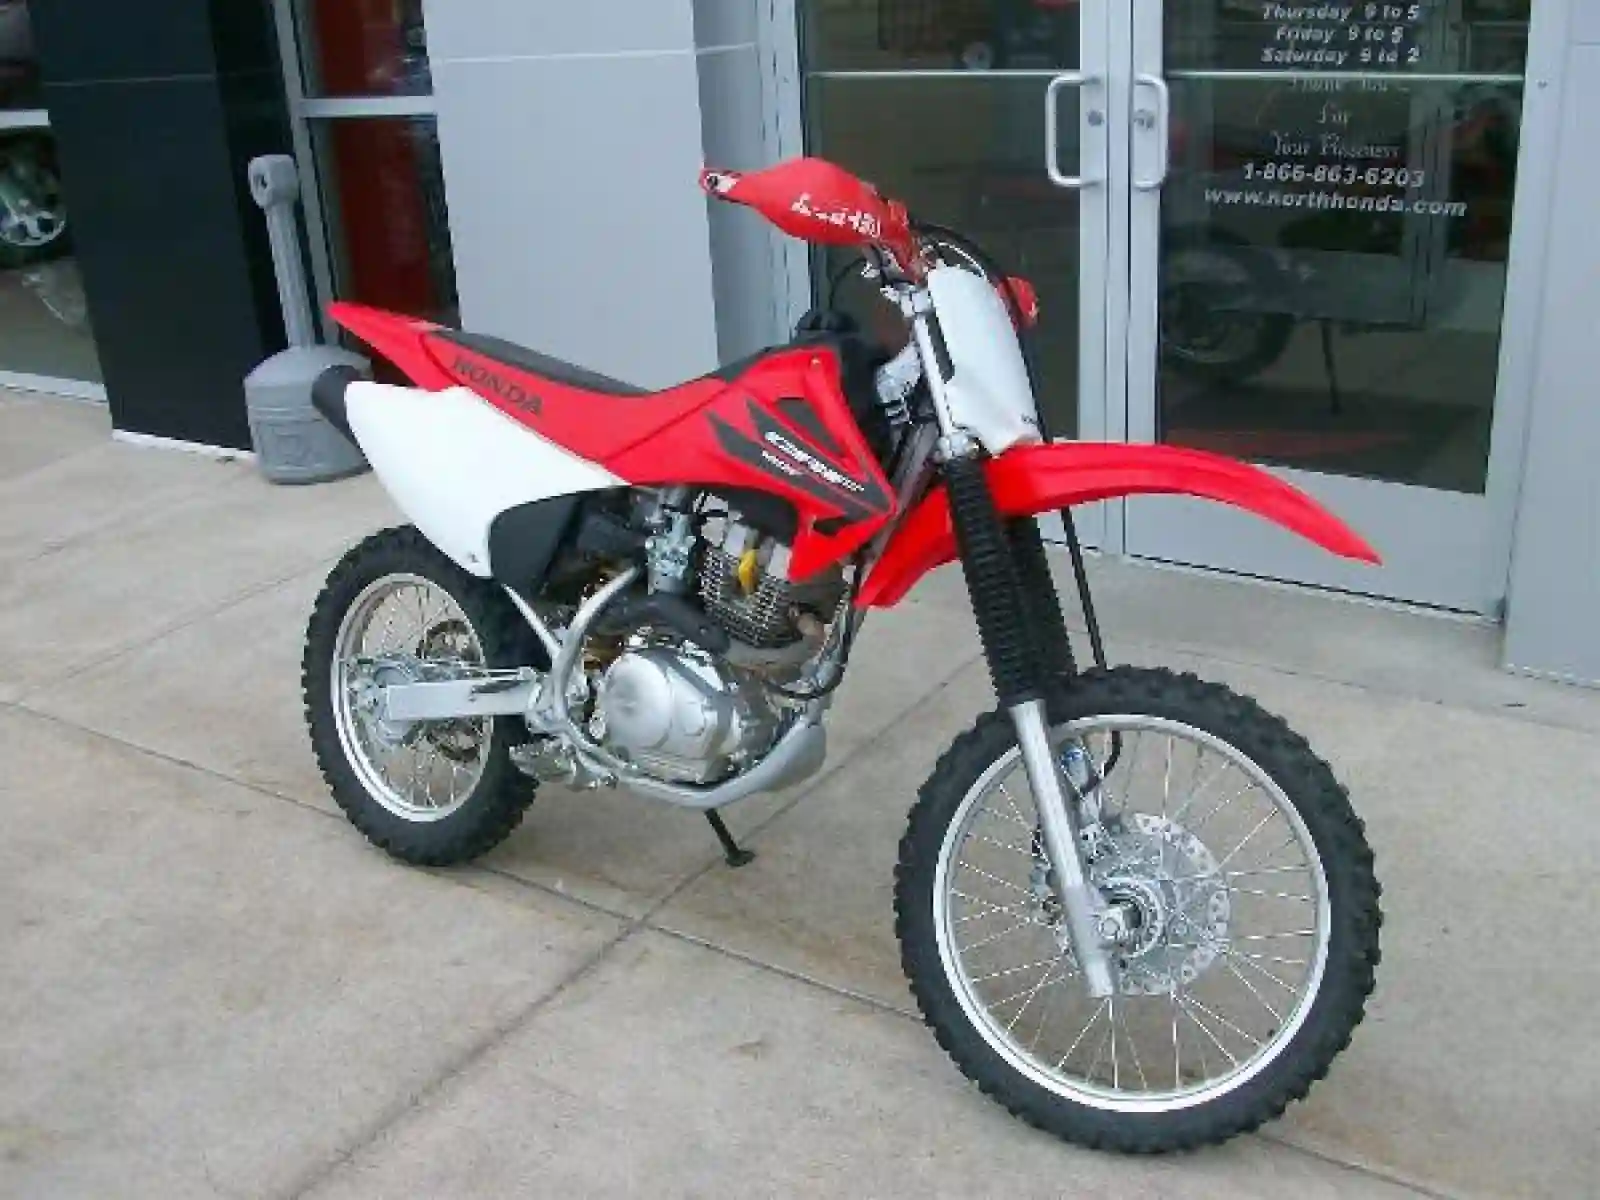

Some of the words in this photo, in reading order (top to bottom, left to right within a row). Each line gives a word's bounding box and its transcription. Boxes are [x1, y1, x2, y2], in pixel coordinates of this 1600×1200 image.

[1261, 3, 1352, 22] Thursday
[1383, 4, 1402, 18] to
[1407, 4, 1420, 20] 5
[1276, 25, 1335, 43] Friday
[1365, 26, 1385, 41] to
[1260, 47, 1349, 65] Saturday
[1378, 47, 1399, 62] to
[1407, 47, 1420, 63] 2
[1243, 162, 1426, 188] 1-866-863-6203
[1204, 188, 1467, 215] www.northhonda.com
[452, 356, 543, 415] HONDA
